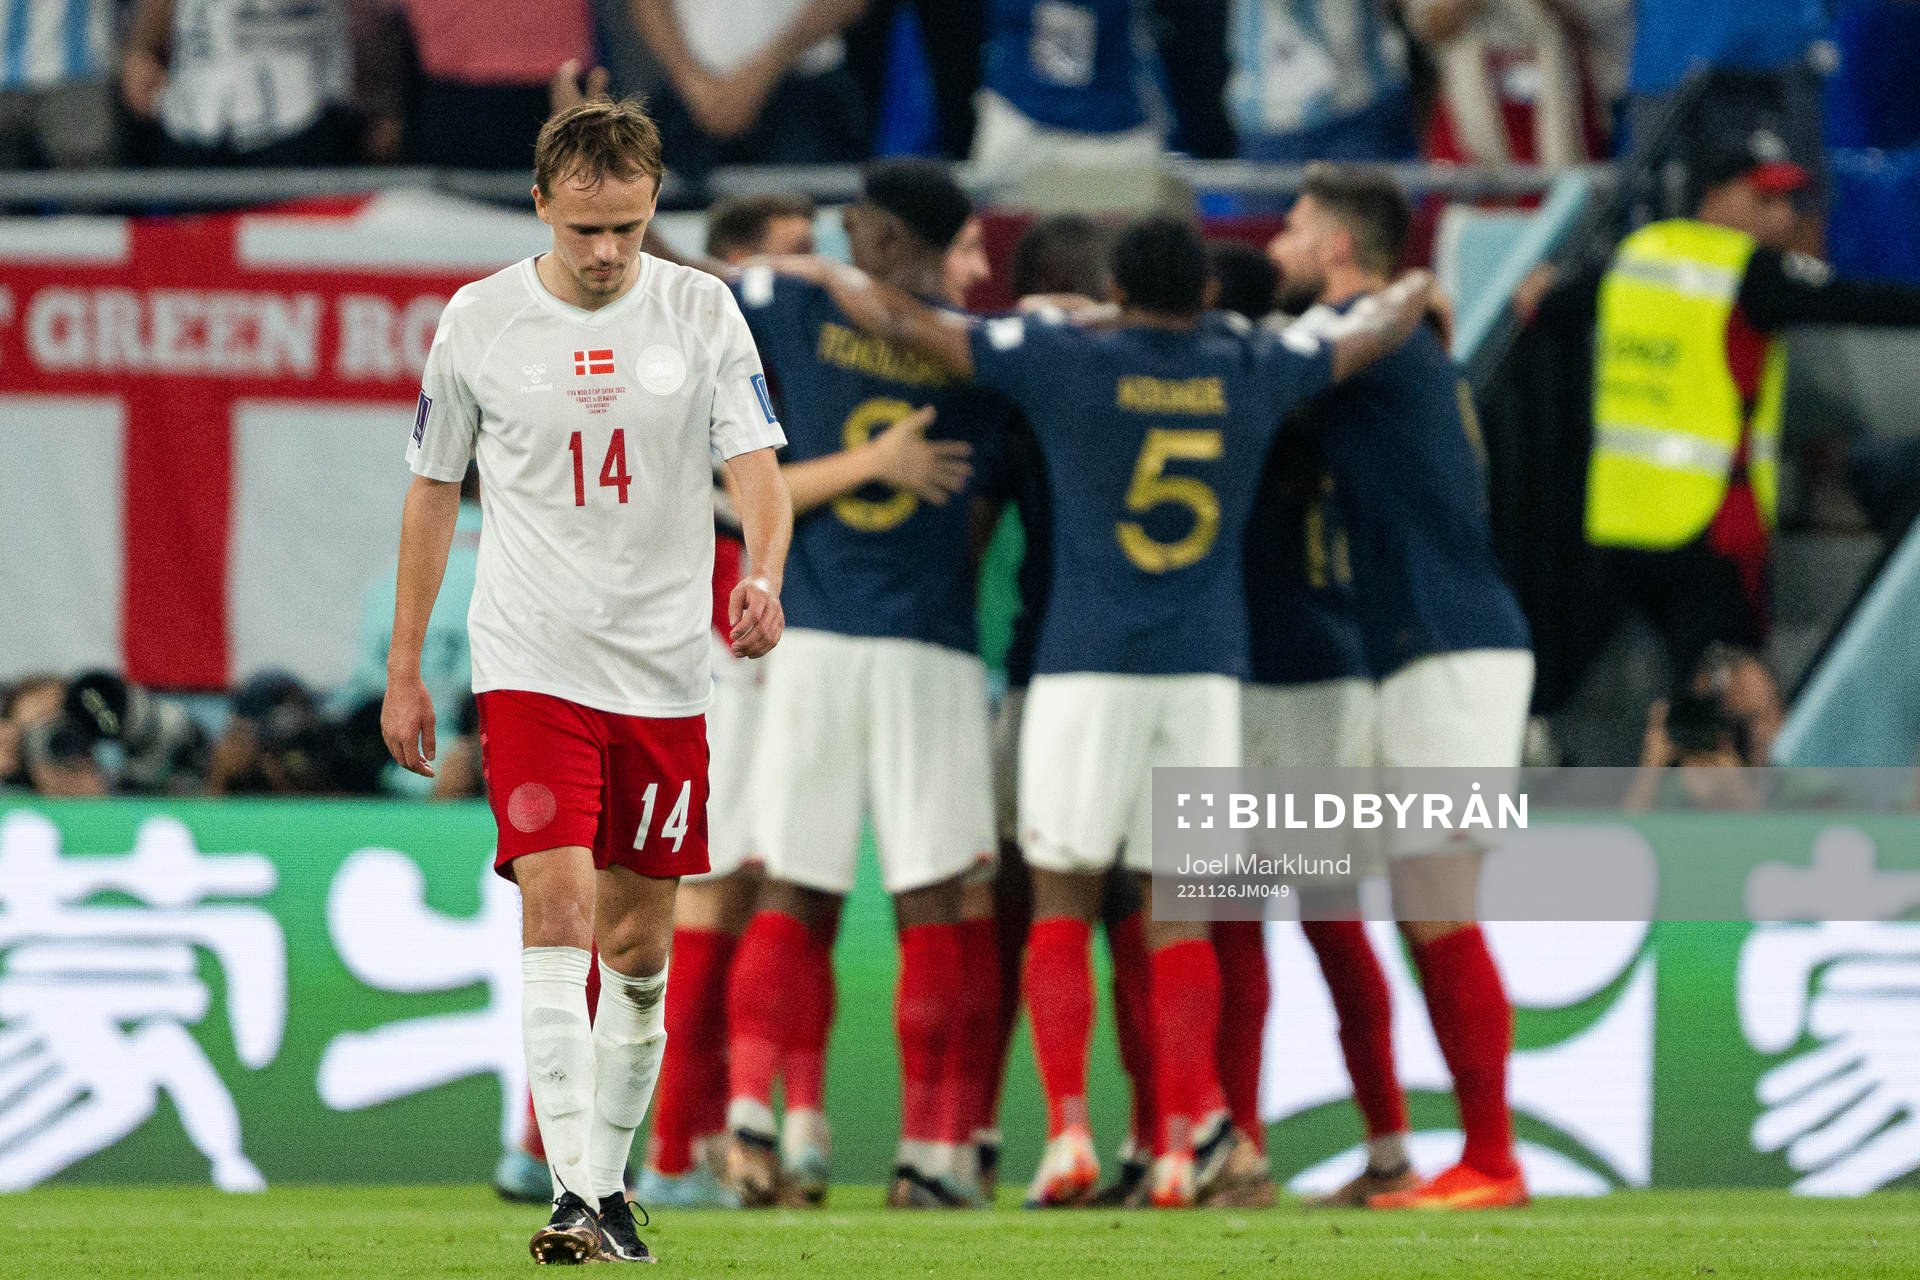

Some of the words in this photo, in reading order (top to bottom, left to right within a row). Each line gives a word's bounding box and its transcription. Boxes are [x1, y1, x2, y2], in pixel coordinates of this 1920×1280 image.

[27, 286, 320, 376] GREEN
[568, 428, 632, 507] 14
[1116, 428, 1222, 574] 5
[633, 779, 692, 853] 14
